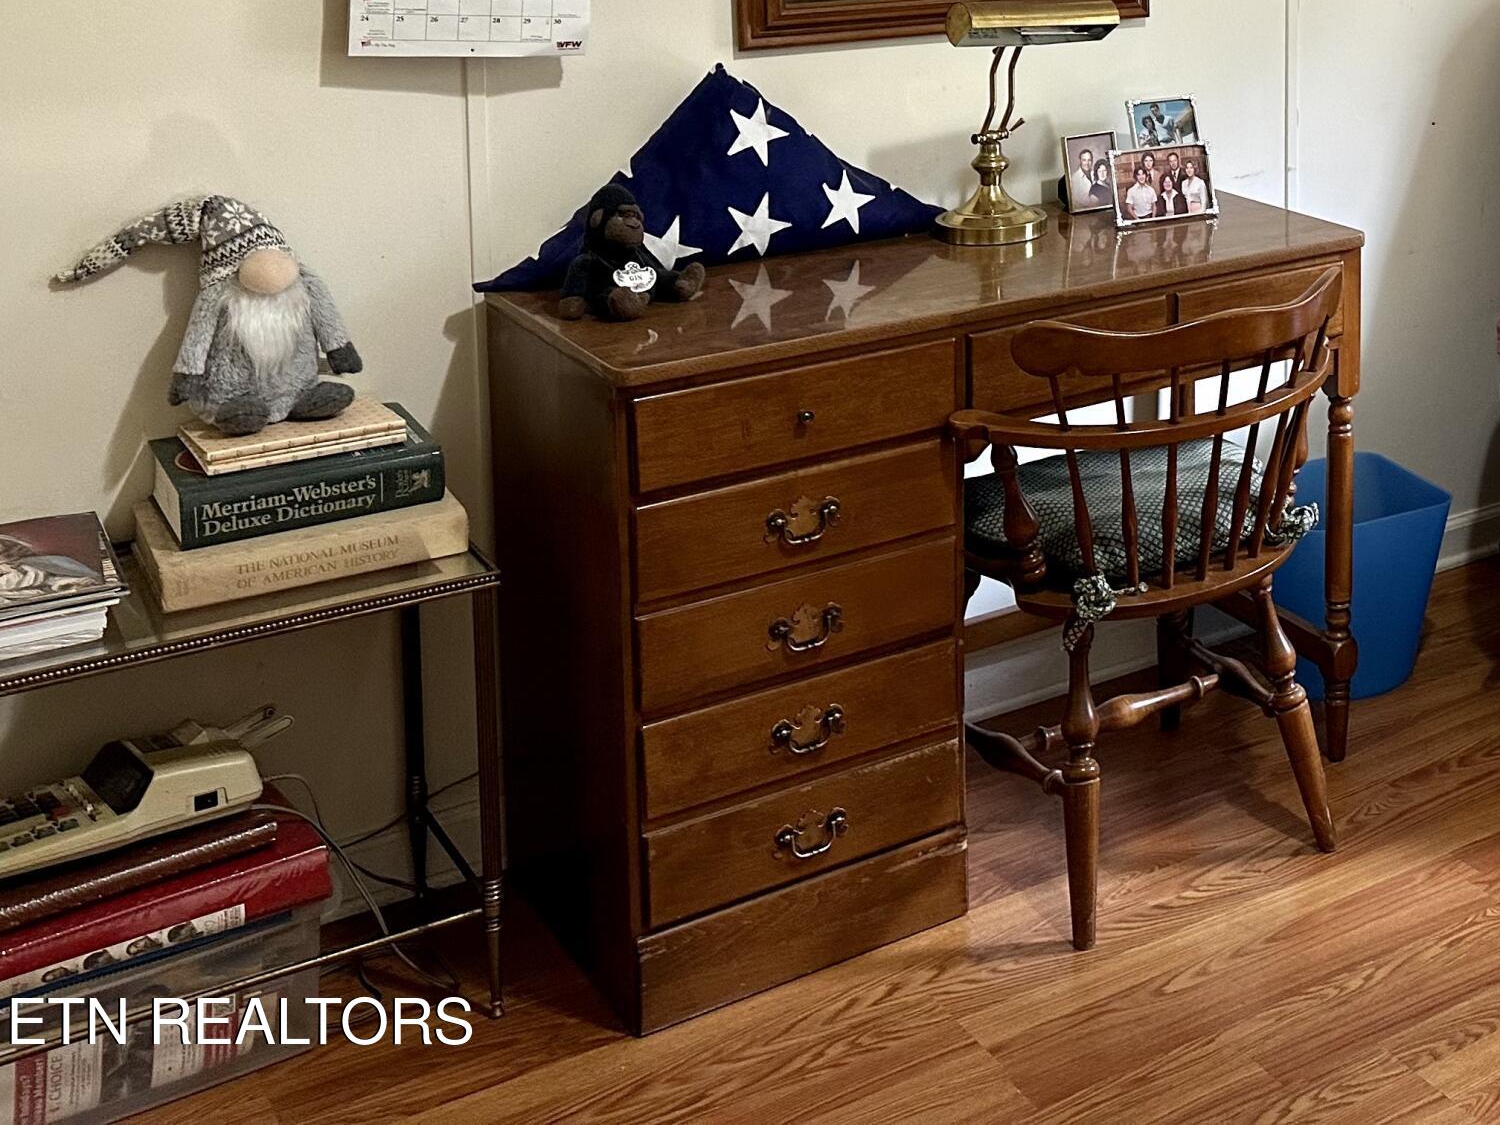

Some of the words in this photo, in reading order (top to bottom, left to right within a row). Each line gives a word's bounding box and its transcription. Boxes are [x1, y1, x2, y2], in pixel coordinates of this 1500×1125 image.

[201, 474, 377, 521] Merriam-Webster's
[203, 513, 272, 537] Deluxe
[277, 492, 377, 522] Dictionary
[236, 562, 267, 576] THE
[269, 548, 340, 569] NATIONAL
[340, 535, 399, 554] MUSEUM
[236, 576, 255, 589] OF
[262, 562, 337, 587] AMERICAN
[344, 548, 399, 569] HISTORY
[48, 1054, 62, 1101] CHOICE
